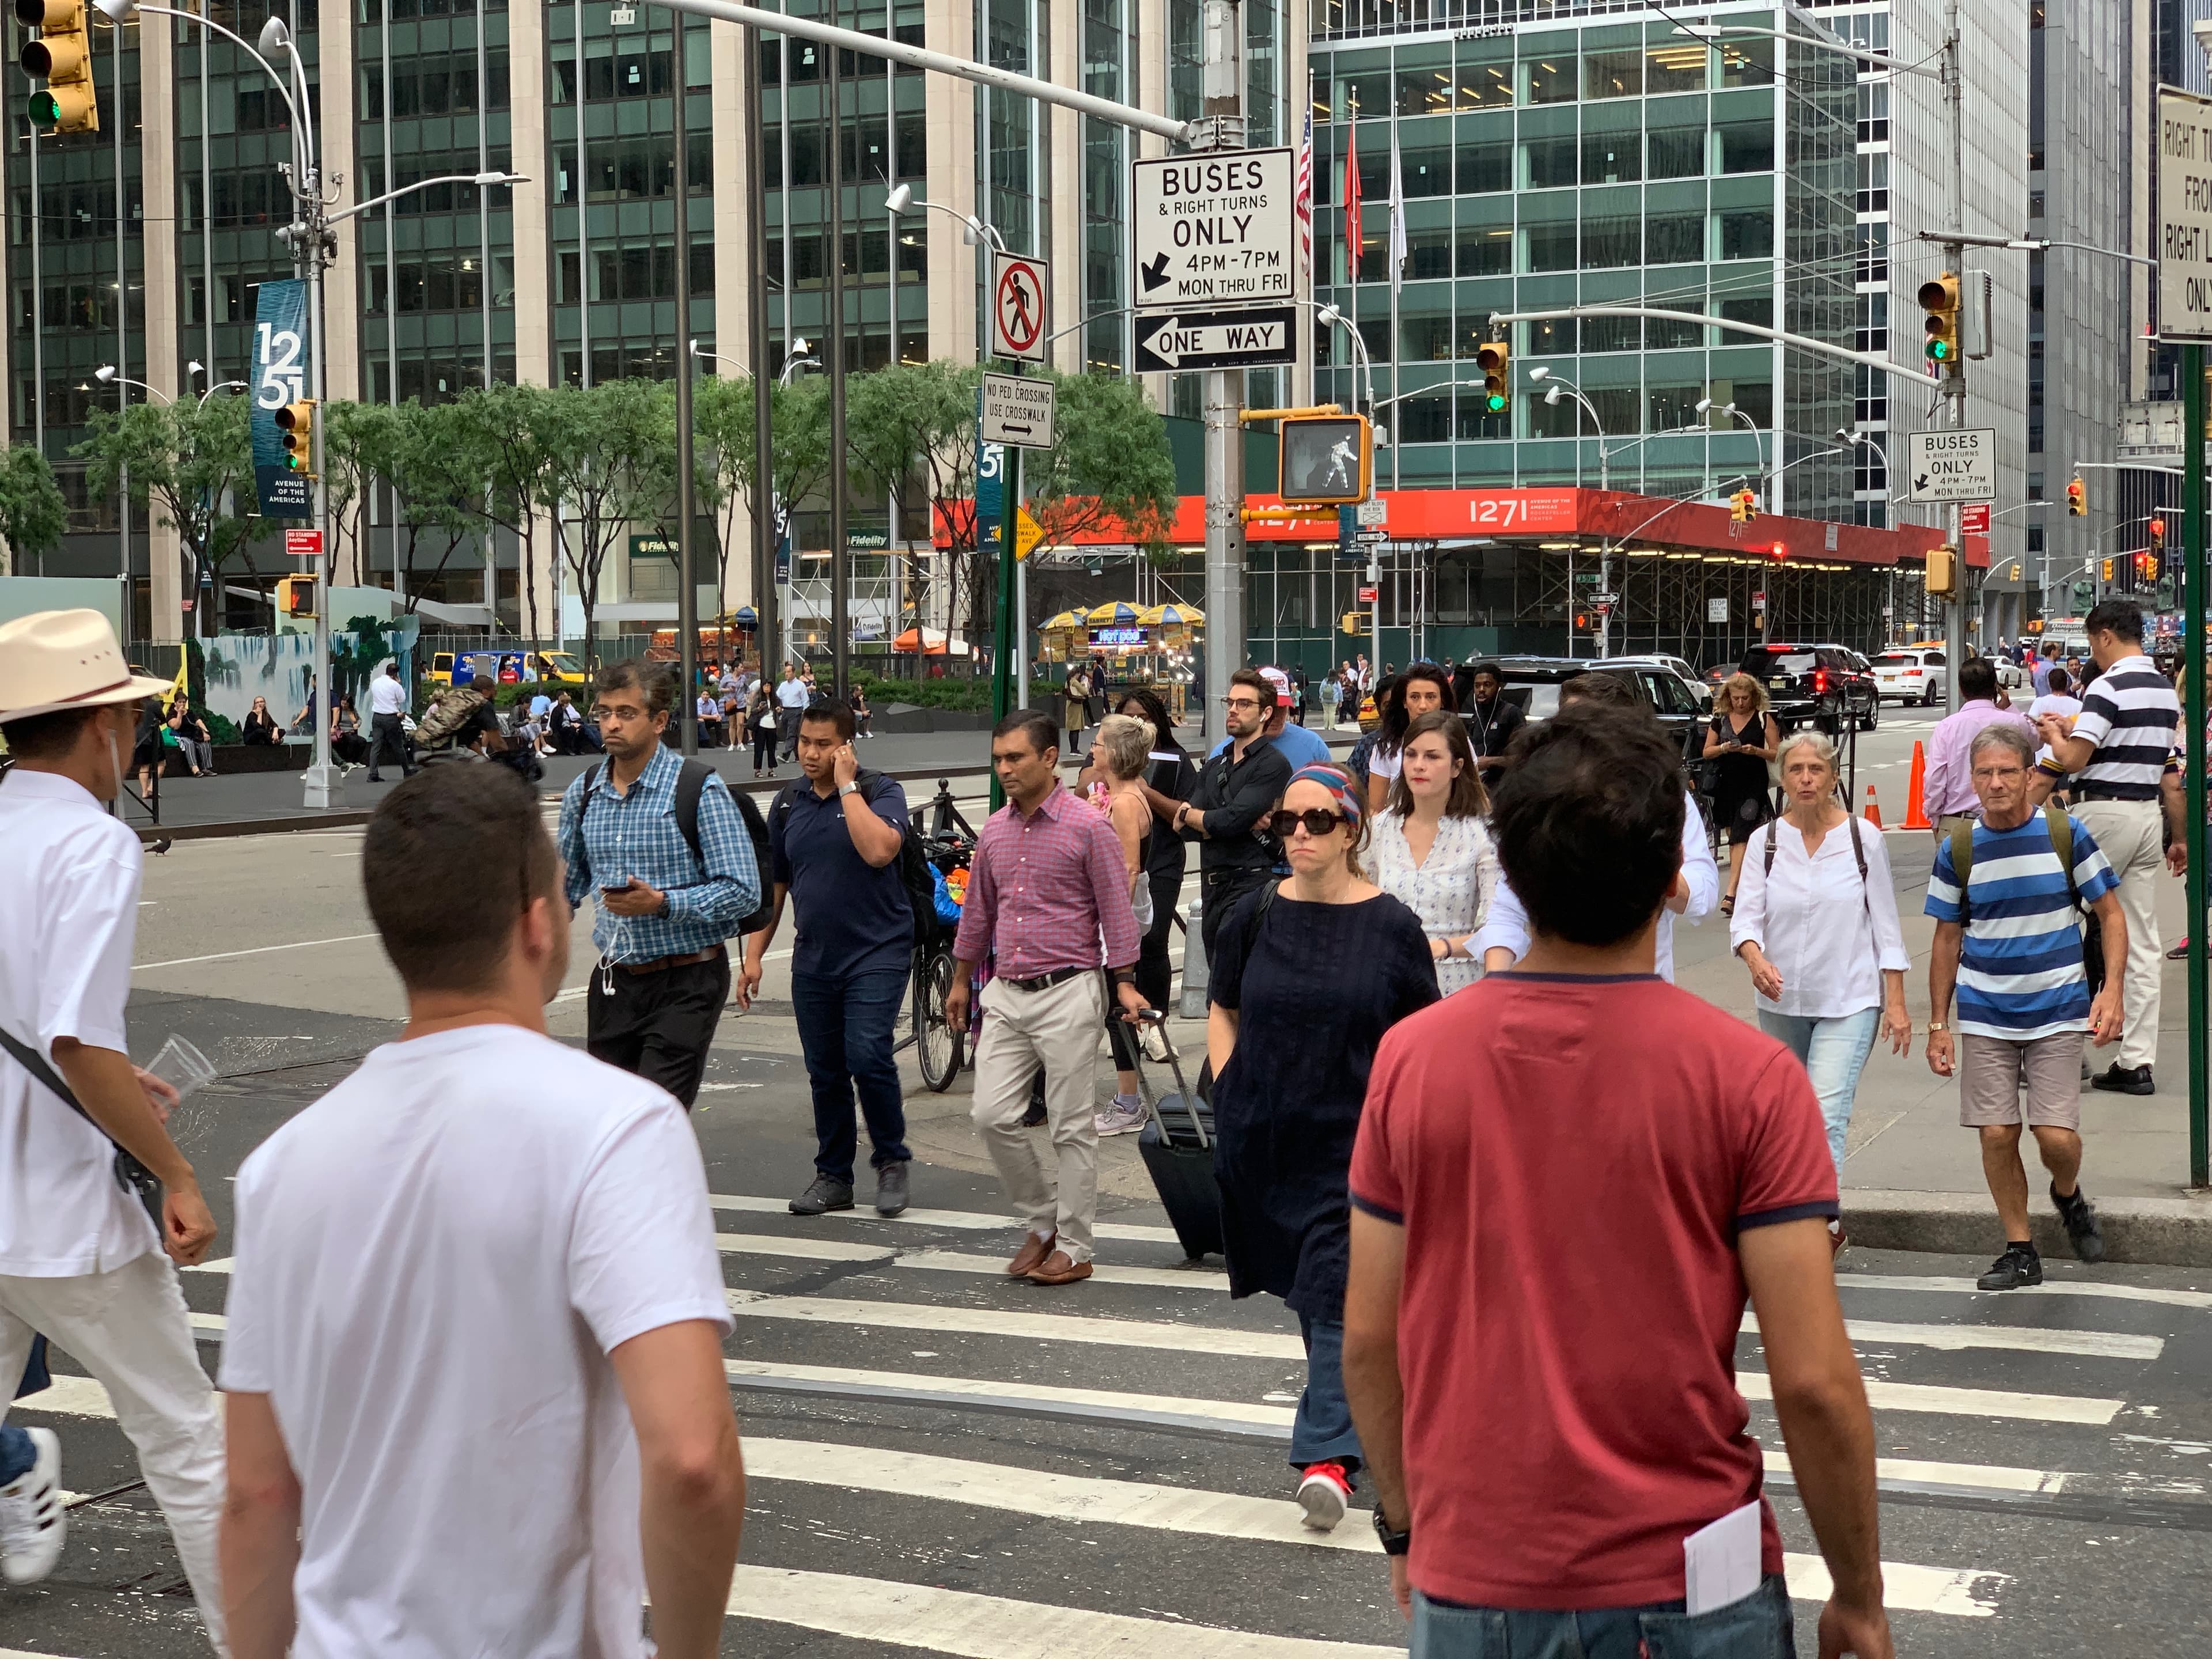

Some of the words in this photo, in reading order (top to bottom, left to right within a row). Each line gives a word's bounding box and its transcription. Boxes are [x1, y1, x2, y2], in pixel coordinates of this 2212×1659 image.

[2165, 120, 2196, 160] RIGHT
[1162, 161, 1263, 196] BUSES
[1159, 203, 1168, 215] &
[1174, 199, 1215, 215] RIGHT
[1221, 195, 1267, 211] TURNS
[1173, 214, 1253, 248] ONLY
[2166, 224, 2200, 262] RIGHT
[1187, 254, 1226, 272] 4PM
[1241, 250, 1280, 269] 7PM
[1179, 279, 1213, 296] MON
[1219, 278, 1255, 294] THRU
[1262, 273, 1287, 291] FRI
[258, 323, 303, 374] 12
[1159, 330, 1203, 353] ONE
[1226, 325, 1275, 349] WAY
[258, 366, 303, 410] 51
[987, 384, 997, 397] NO
[999, 385, 1013, 400] PED.
[1015, 387, 1050, 404] CROSSING
[990, 403, 1002, 417] USE
[1005, 406, 1046, 422] CROSSWALK
[1925, 435, 1978, 450] BUSES
[1931, 460, 1972, 475] ONLY
[1934, 488, 1953, 497] MON
[1978, 486, 1991, 494] FRI
[1940, 477, 1959, 485] 4PM
[1968, 476, 1986, 484] 7PM
[1470, 499, 1527, 527] 1271
[851, 535, 887, 546] Fidelity
[1099, 631, 1119, 641] HOT
[1119, 631, 1139, 641] DOG
